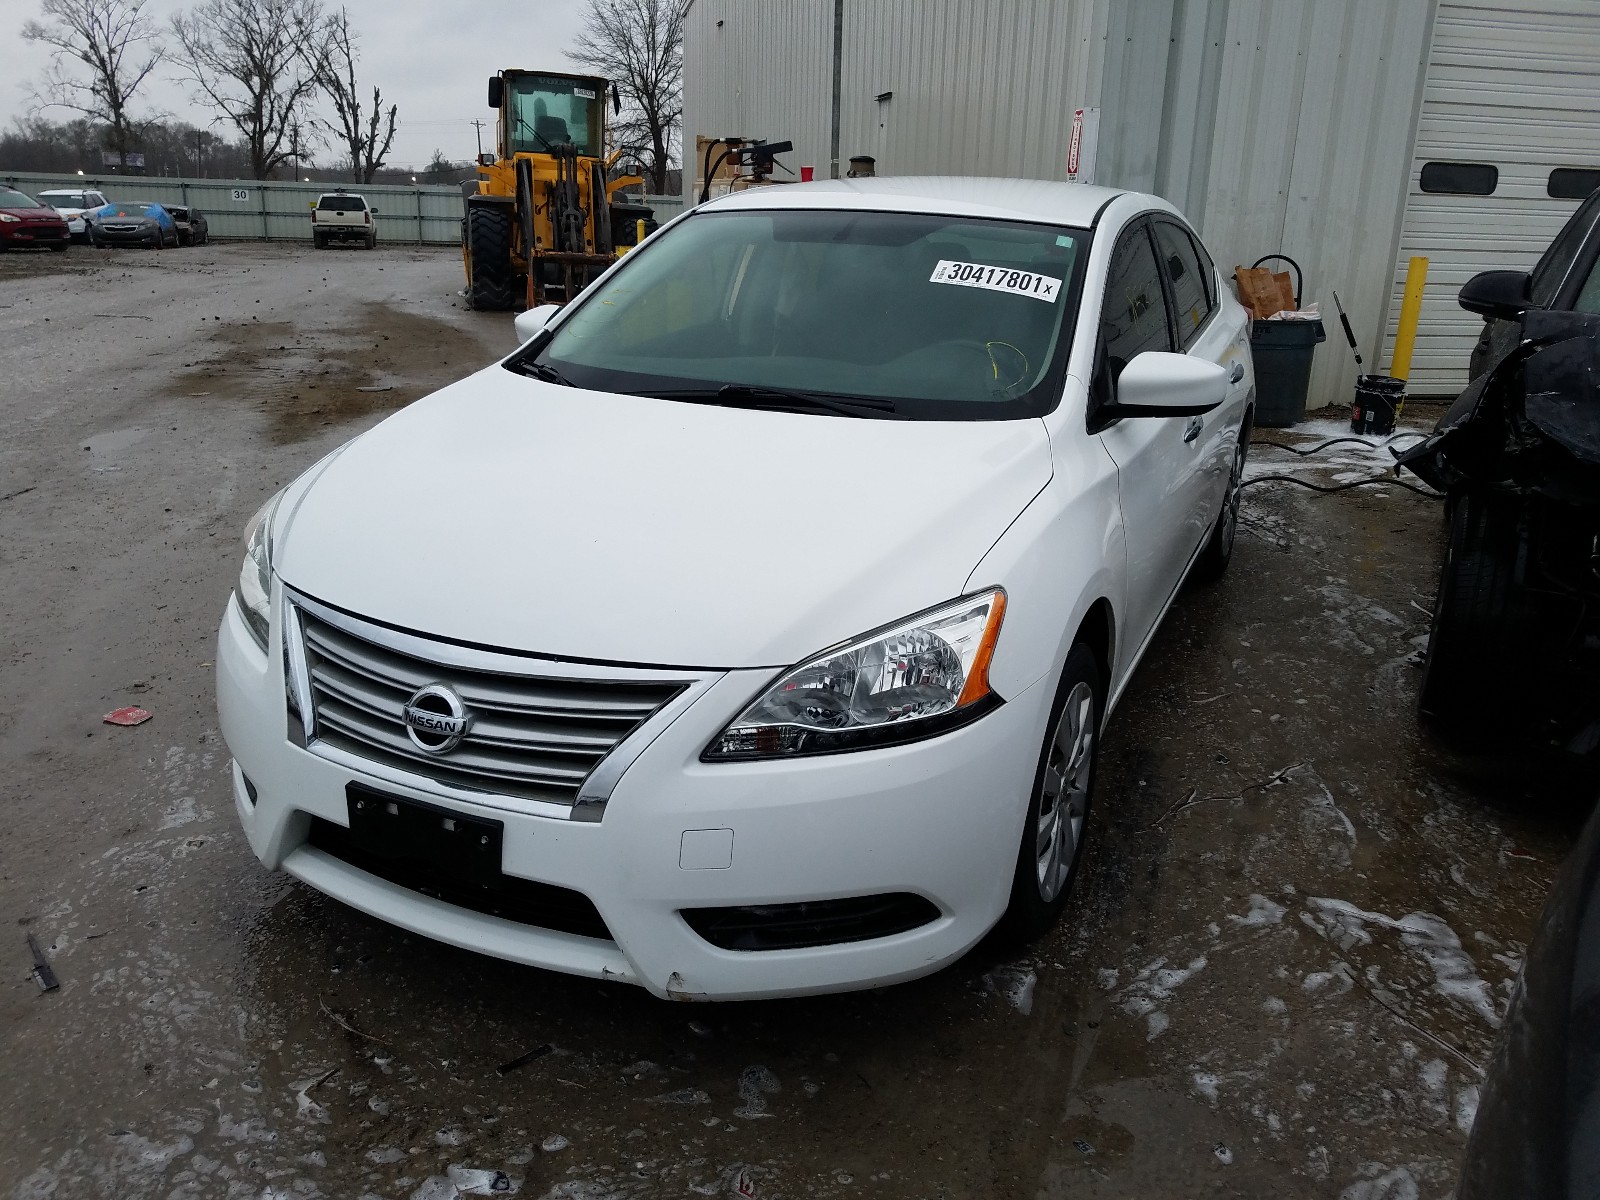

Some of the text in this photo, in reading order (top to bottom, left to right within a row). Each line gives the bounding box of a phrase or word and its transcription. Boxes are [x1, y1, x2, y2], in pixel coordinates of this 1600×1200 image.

[538, 78, 577, 87] VOLVO
[234, 190, 246, 199] 30
[947, 263, 1043, 293] 30417801
[405, 711, 456, 732] NISSAN
